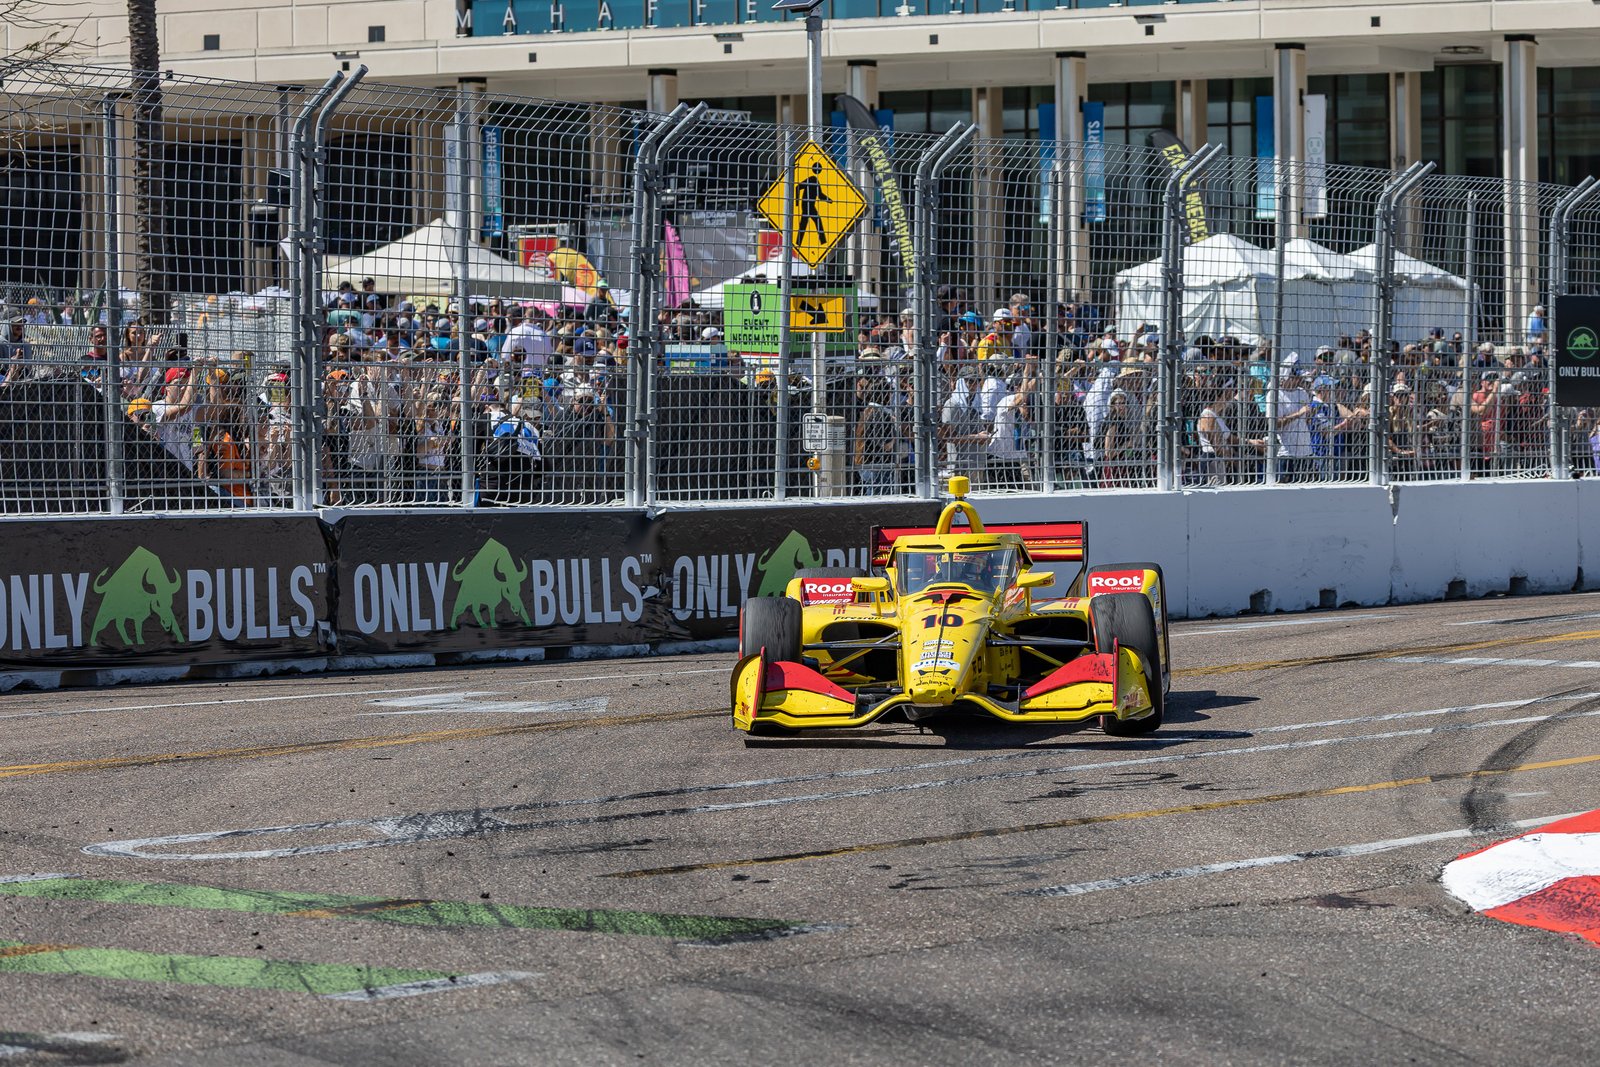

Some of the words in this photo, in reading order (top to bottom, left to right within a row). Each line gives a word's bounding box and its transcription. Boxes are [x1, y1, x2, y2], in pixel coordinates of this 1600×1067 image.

[744, 319, 769, 330] EVENT
[1559, 366, 1580, 377] ONLY
[672, 552, 756, 621] ONLY
[1091, 576, 1142, 587] Root
[805, 583, 853, 593] Root
[354, 561, 449, 634] ONLY
[921, 614, 964, 629] 10
